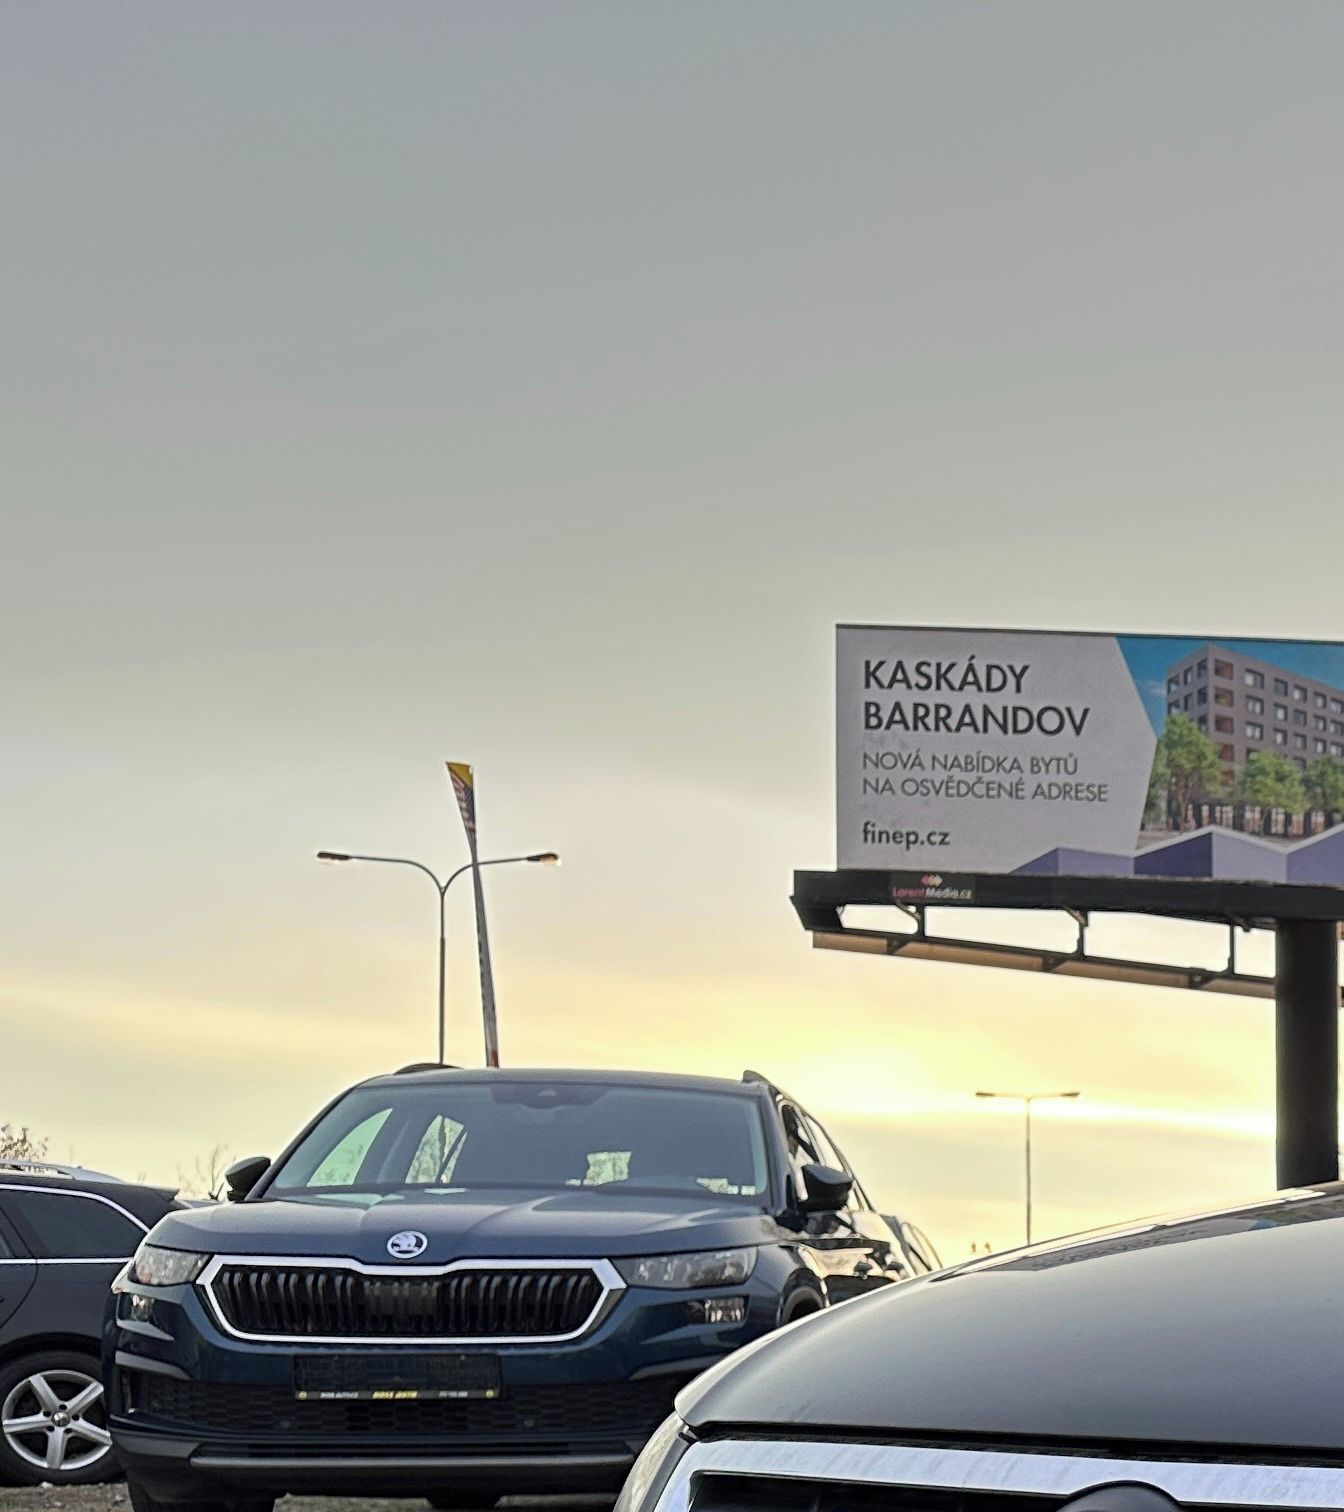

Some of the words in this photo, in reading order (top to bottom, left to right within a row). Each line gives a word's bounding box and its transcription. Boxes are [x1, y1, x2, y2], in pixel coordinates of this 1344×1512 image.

[863, 654, 1030, 694] KASKÁDY
[863, 701, 1091, 737] BARRANDOV
[862, 748, 925, 771] NOVÁ
[931, 751, 1024, 775] NABÍDKA
[1030, 752, 1079, 776] BYTŮ
[862, 777, 896, 796] NA
[901, 775, 1026, 801] OSVĚDČENÉ
[1031, 782, 1109, 803] ADRESE
[862, 821, 951, 850] finep.cz
